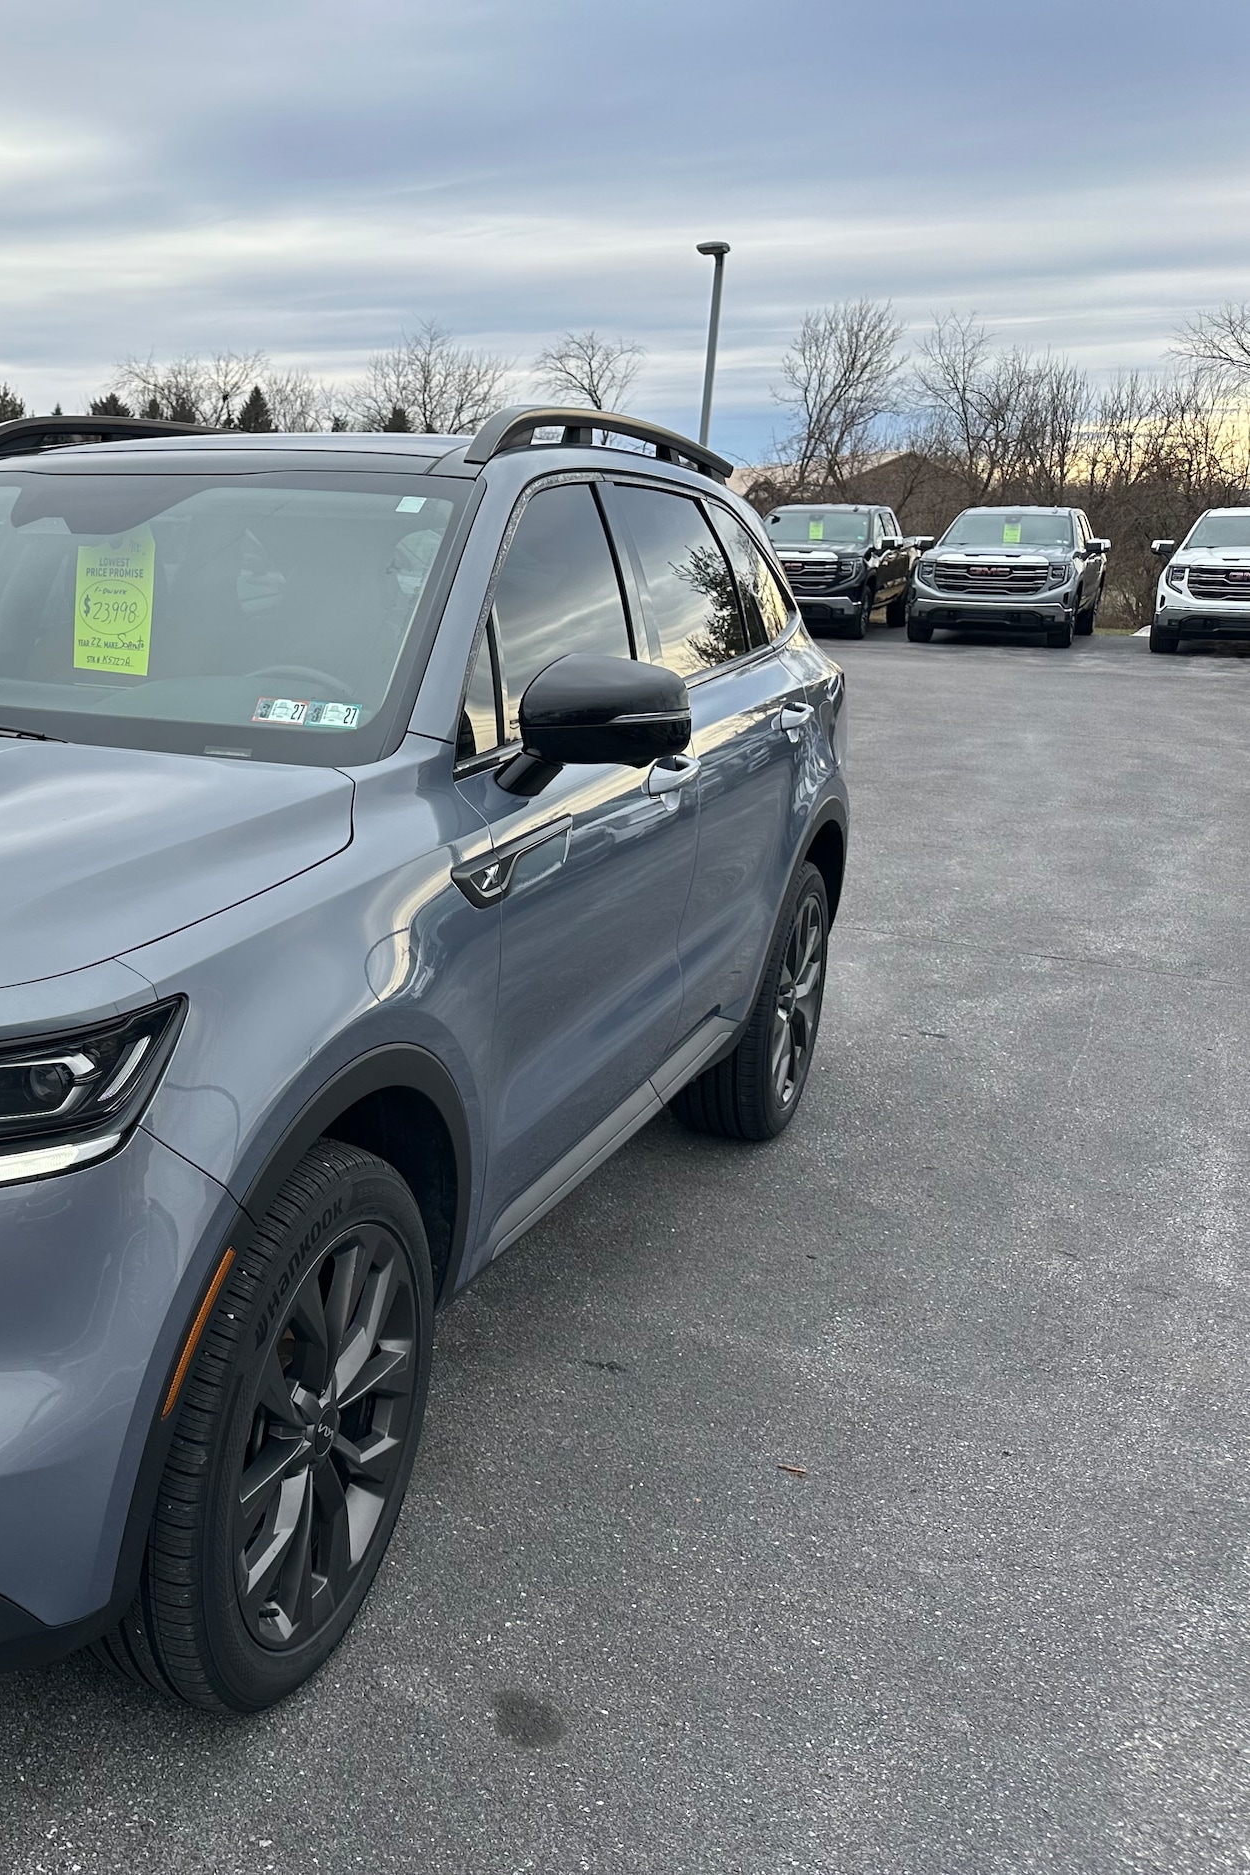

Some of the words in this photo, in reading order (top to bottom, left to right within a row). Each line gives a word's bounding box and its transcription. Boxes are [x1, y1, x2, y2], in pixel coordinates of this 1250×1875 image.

[99, 556, 130, 567] LOWEST
[86, 567, 107, 577] PRICE
[109, 568, 144, 578] PROMISE
[969, 566, 1011, 576] GMC
[78, 638, 90, 647] YEAR
[103, 640, 118, 649] MAKE
[290, 703, 306, 720] 27
[343, 707, 358, 725] 27
